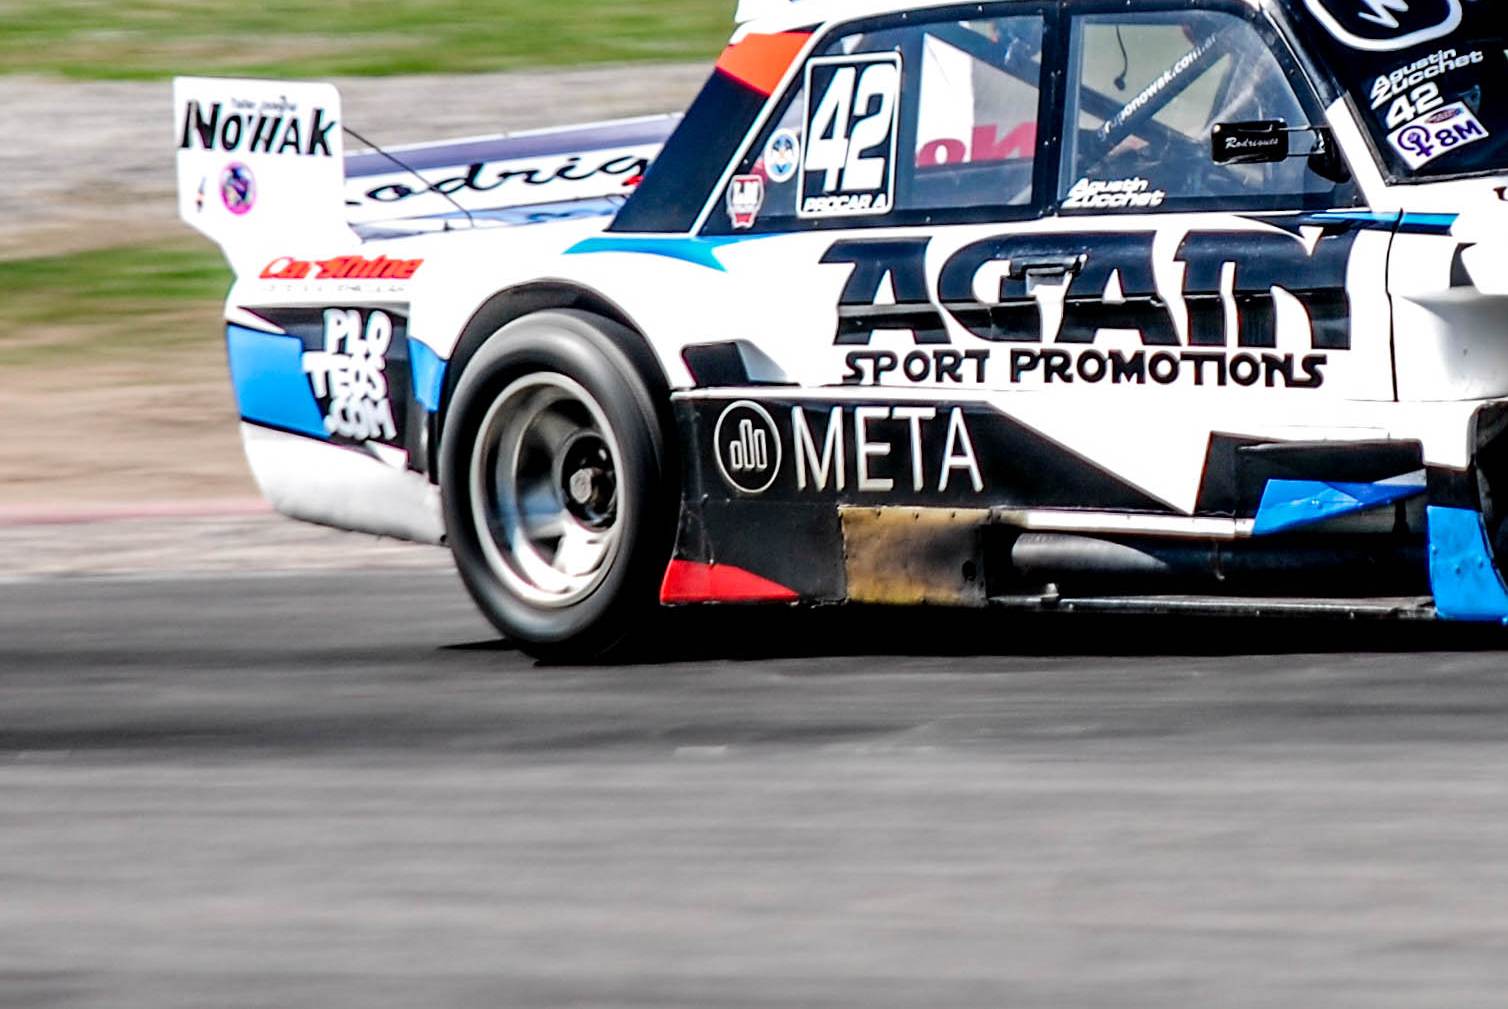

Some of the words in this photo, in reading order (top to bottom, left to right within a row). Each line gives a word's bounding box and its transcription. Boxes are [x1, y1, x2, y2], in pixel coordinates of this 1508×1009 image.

[1370, 49, 1457, 100] Agustin
[1370, 50, 1484, 111] Zucchet
[805, 63, 897, 192] 42
[1385, 81, 1444, 129] 42
[1435, 120, 1483, 147] 8M
[803, 194, 873, 213] PROCAR
[871, 193, 888, 211] A
[1061, 189, 1166, 209] Zucchet
[1068, 177, 1149, 196] Agustin
[818, 230, 1360, 350] AGAIN
[842, 349, 991, 387] SPORT
[1010, 348, 1328, 388] PROMOTIONS
[791, 405, 984, 492] META
